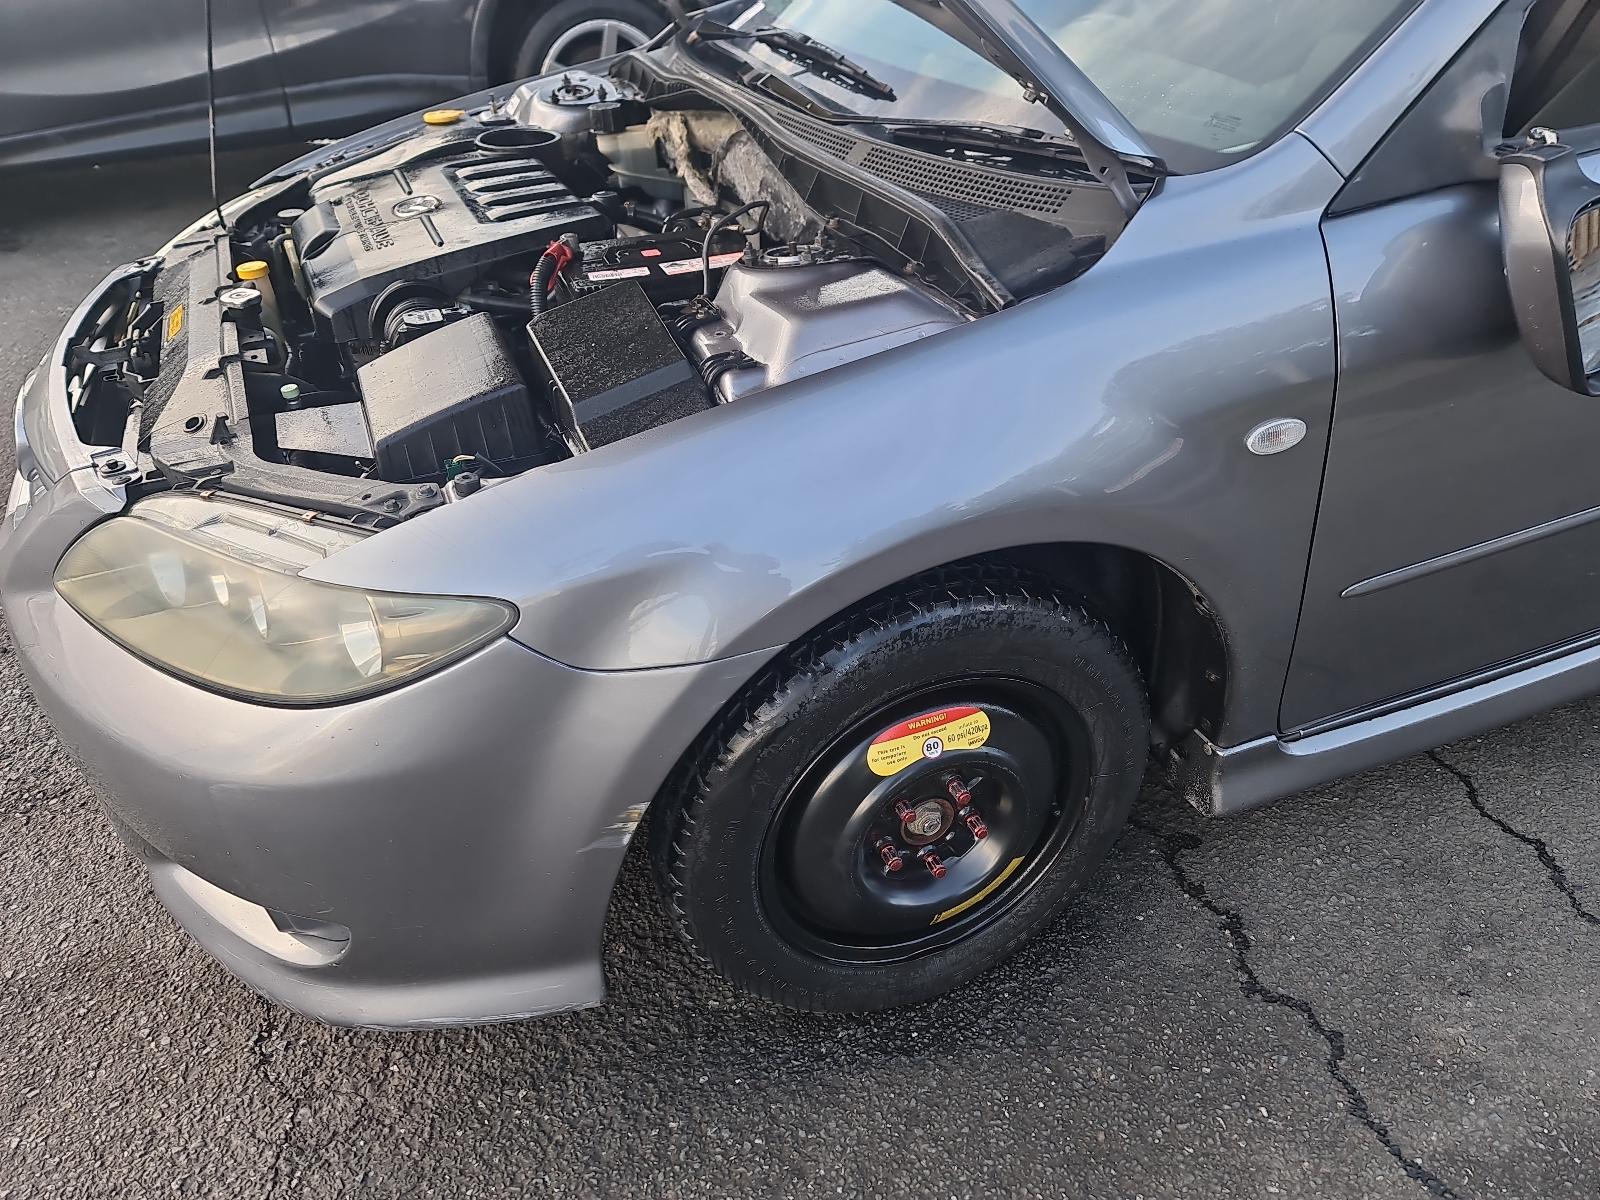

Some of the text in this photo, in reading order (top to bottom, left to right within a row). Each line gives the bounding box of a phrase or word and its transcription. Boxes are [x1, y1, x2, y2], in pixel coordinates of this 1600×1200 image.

[907, 712, 947, 730] WARNING!
[926, 741, 939, 752] 80
[896, 755, 908, 763] only
